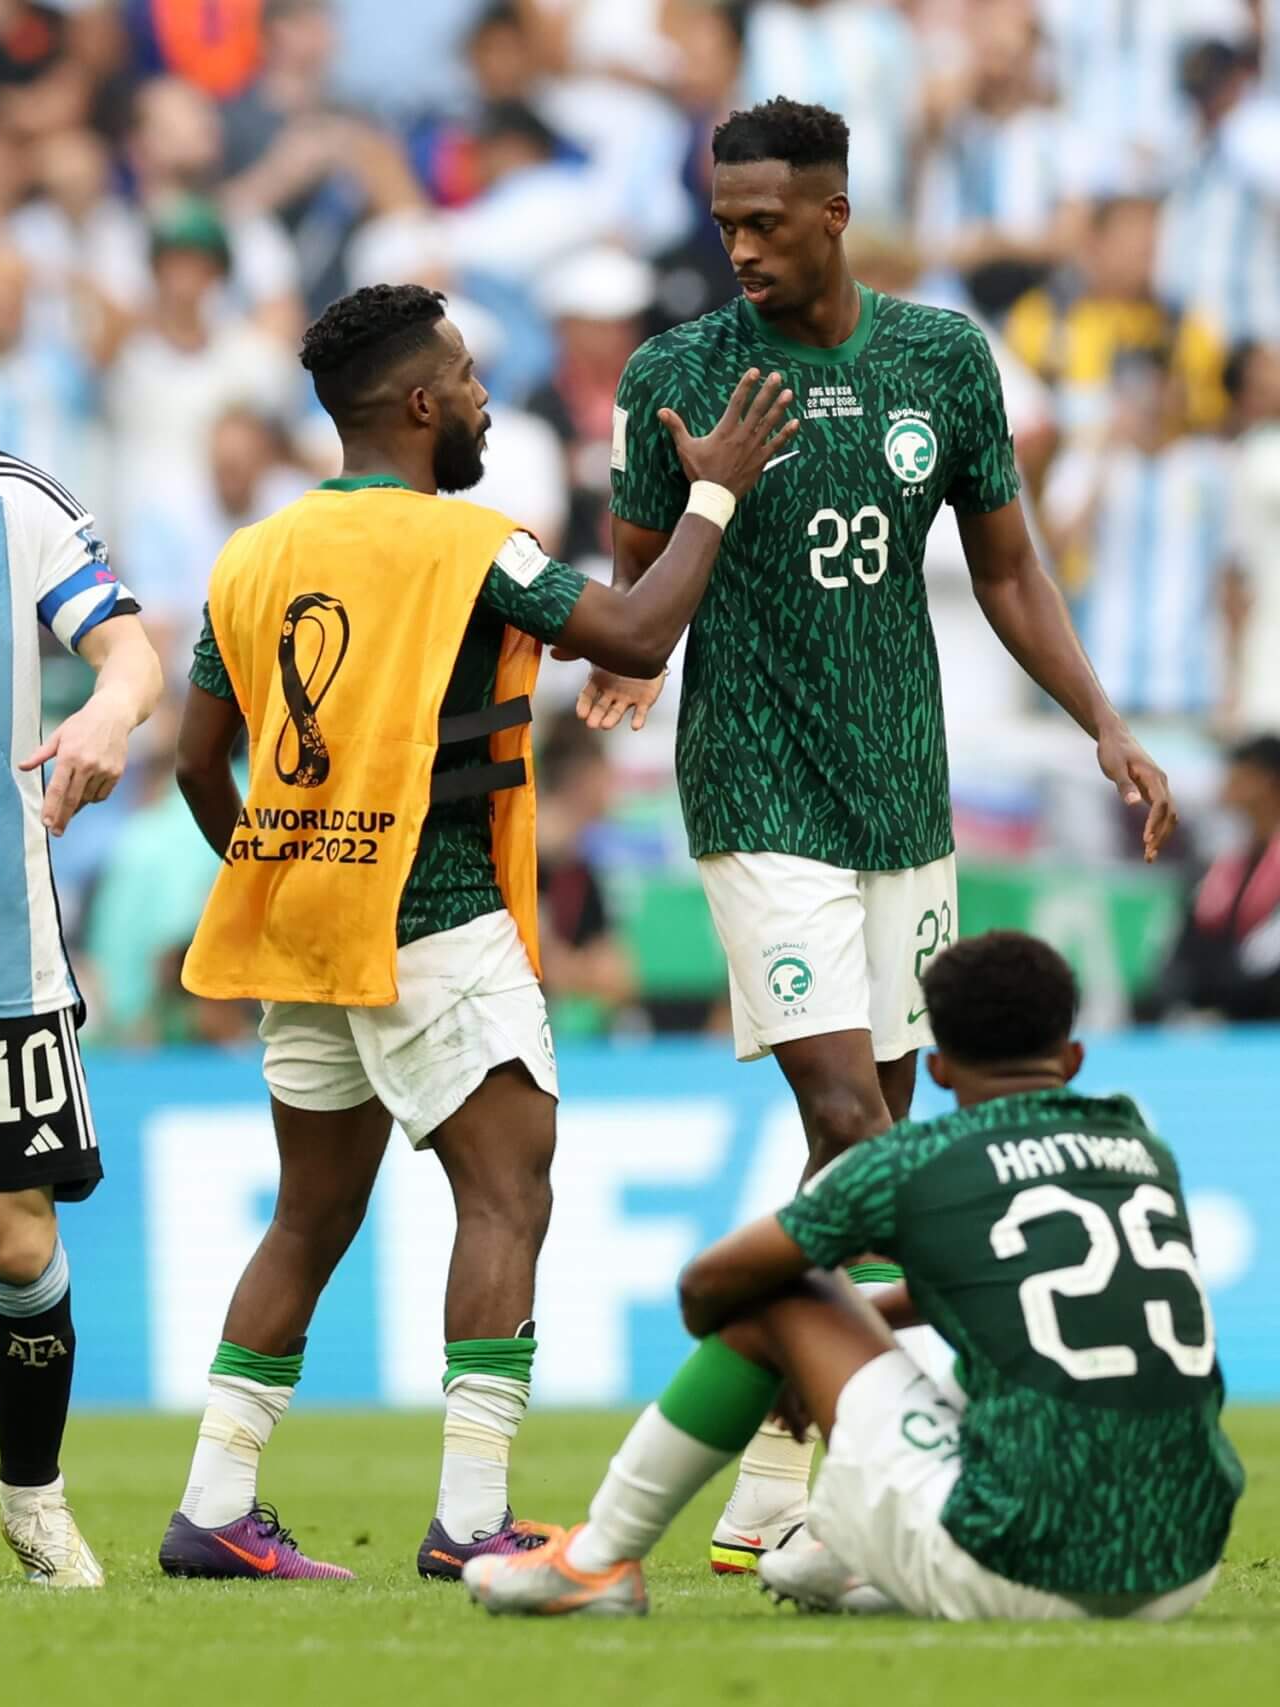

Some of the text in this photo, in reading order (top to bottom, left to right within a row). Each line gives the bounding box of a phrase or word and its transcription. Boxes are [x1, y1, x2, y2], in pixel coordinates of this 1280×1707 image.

[807, 505, 890, 589] 23
[225, 836, 378, 867] atar2022
[784, 1006, 808, 1017] KSA
[144, 1108, 822, 1414] FIF
[989, 1184, 1215, 1381] 25
[7, 1331, 68, 1367] AFA
